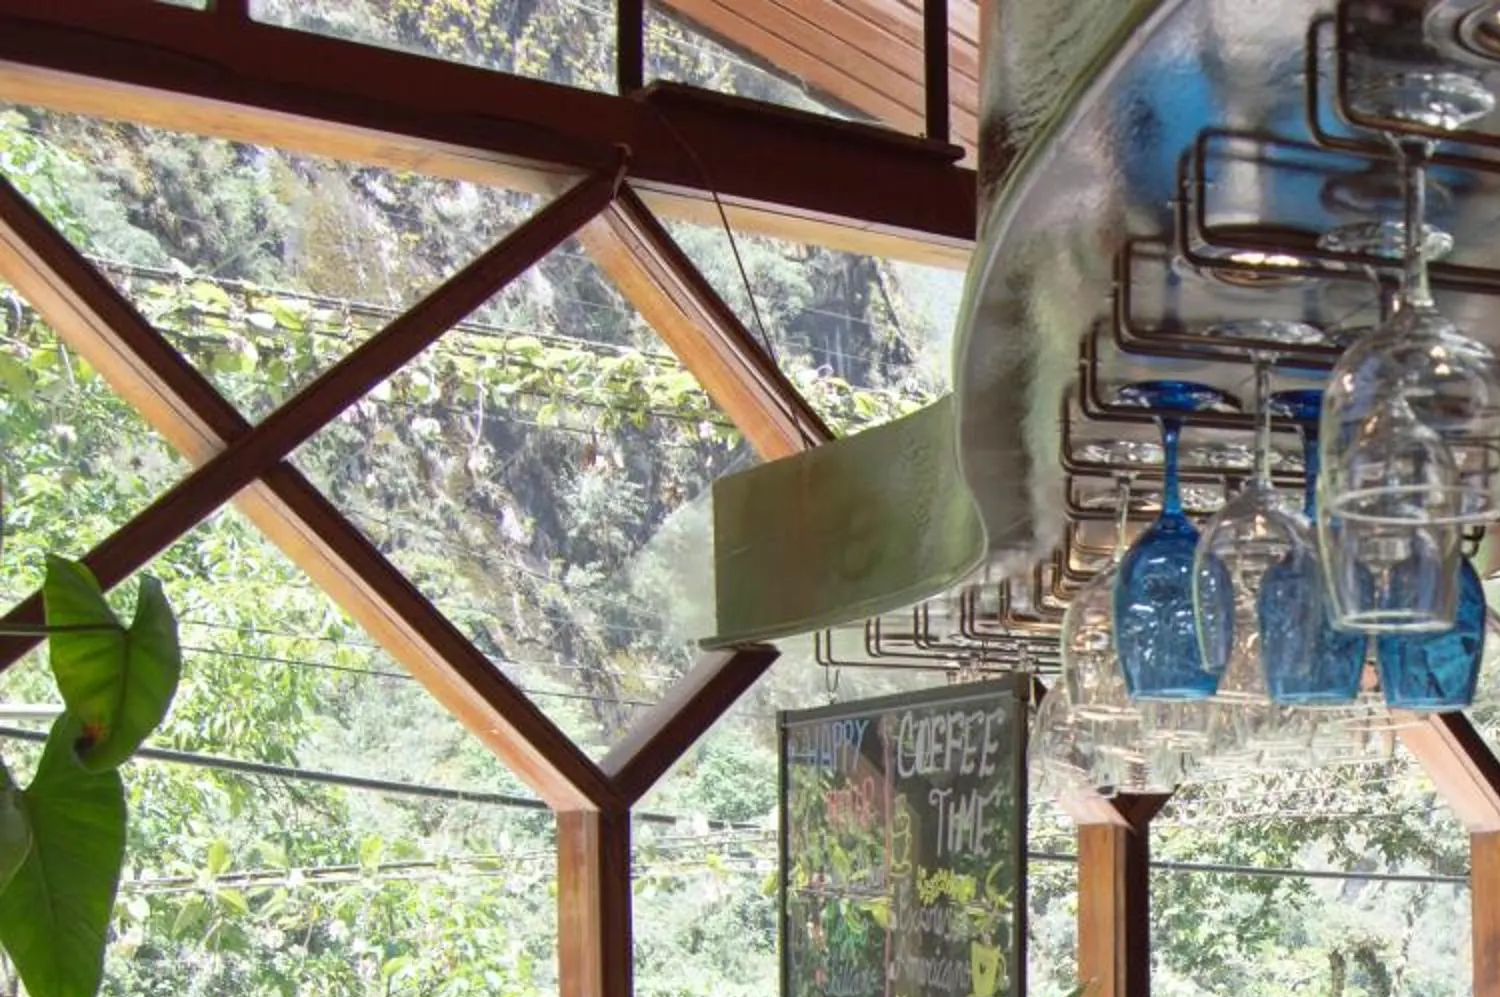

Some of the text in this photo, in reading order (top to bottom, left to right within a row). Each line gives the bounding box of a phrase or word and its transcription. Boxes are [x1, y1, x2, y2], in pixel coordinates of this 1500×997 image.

[790, 718, 870, 771] HAPPY
[897, 708, 1006, 778] COFFEE
[928, 780, 1004, 858] TIME
